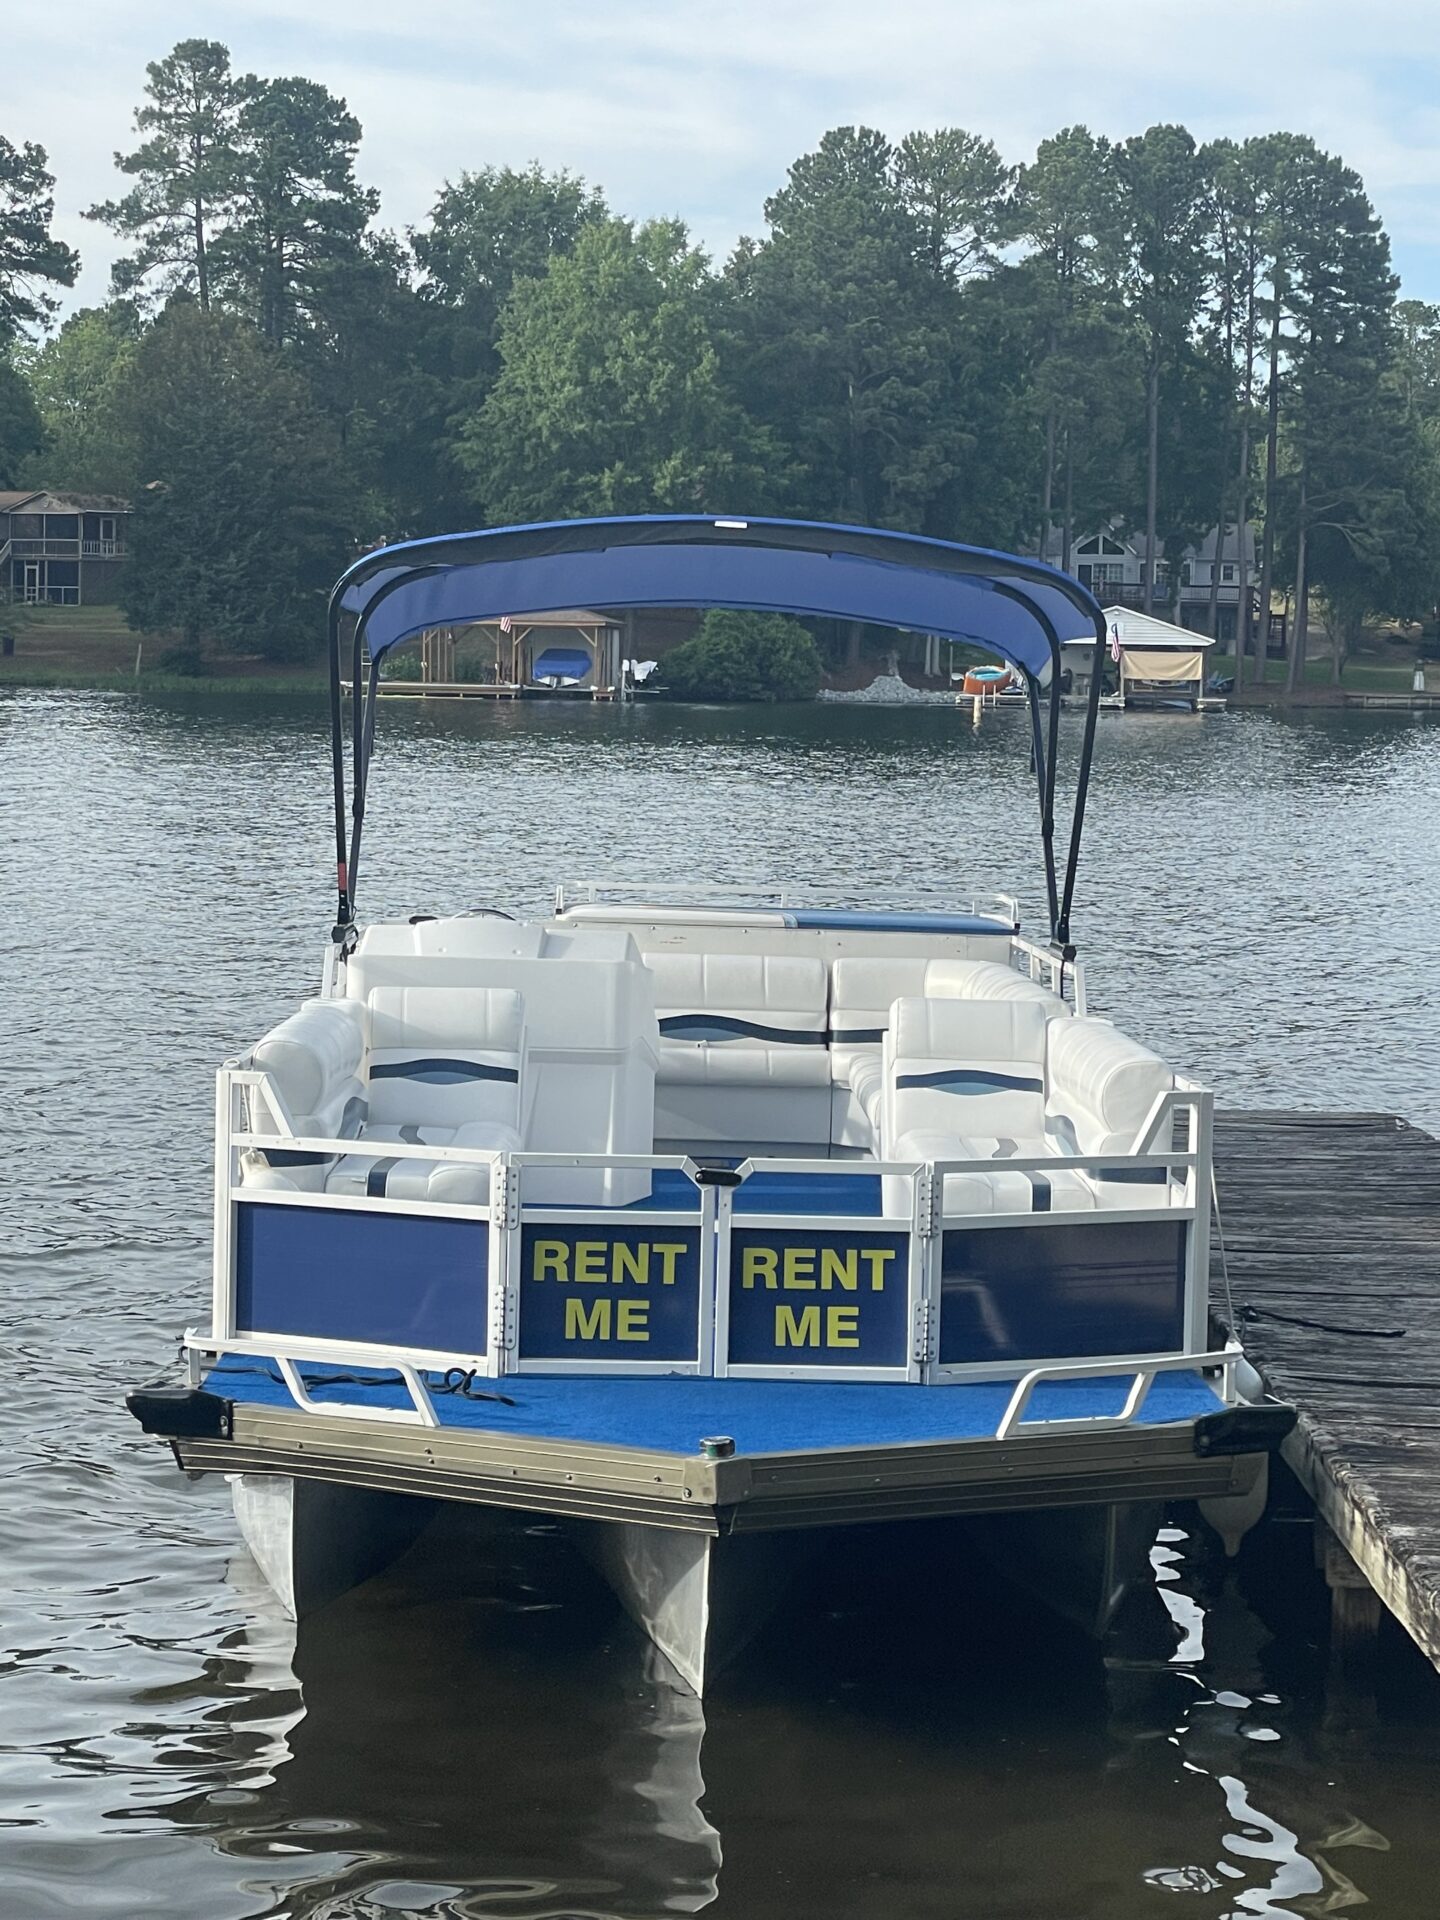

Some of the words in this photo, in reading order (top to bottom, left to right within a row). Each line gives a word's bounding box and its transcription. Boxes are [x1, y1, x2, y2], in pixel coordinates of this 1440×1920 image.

[533, 1241, 687, 1284] RENT
[742, 1248, 896, 1291] RENT
[565, 1299, 650, 1341] ME
[775, 1306, 860, 1348] ME
